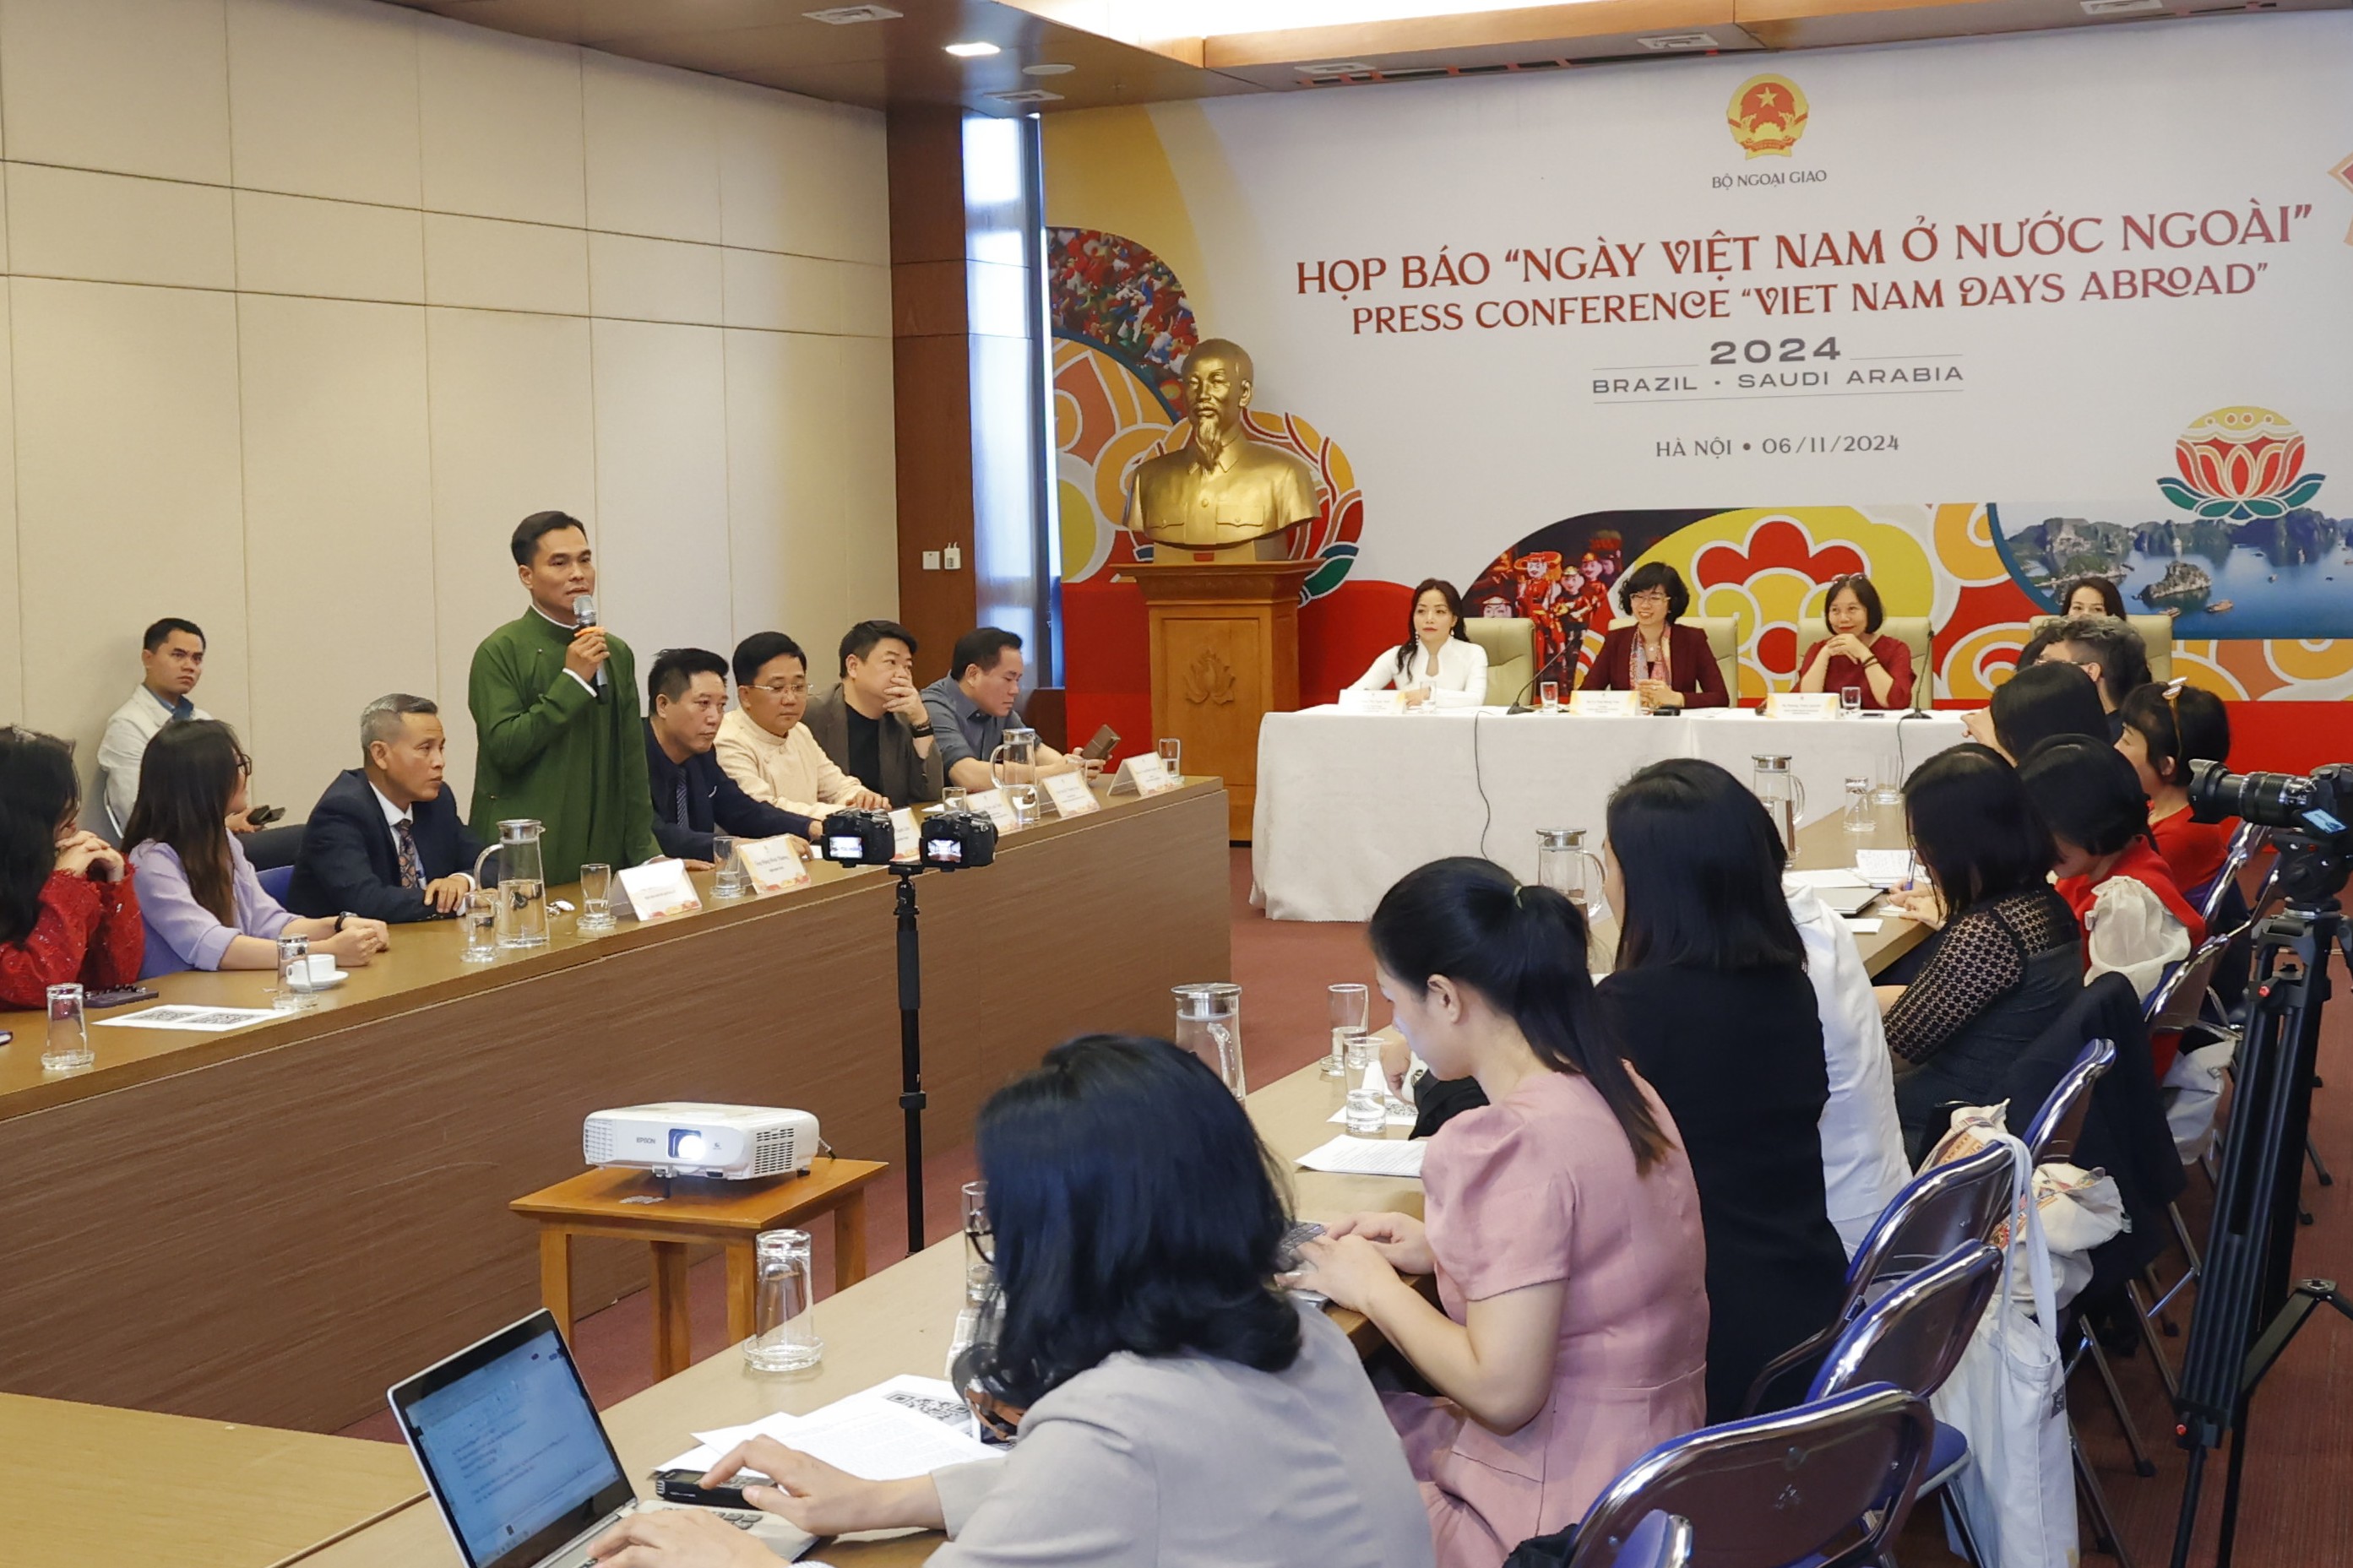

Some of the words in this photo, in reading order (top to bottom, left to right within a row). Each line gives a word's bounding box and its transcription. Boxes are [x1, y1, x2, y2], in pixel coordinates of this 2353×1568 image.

[1712, 173, 1733, 191] BỘ
[1736, 172, 1785, 187] NGOẠI
[1789, 170, 1828, 183] GIAO
[1296, 258, 1387, 301] HỌP
[1401, 244, 1491, 290] BÁO
[1660, 229, 1760, 282] VIỆT
[1774, 229, 1886, 269] NAM
[1902, 215, 1939, 263] Ở
[1955, 209, 2104, 260] NƯỚC
[1352, 303, 1465, 335] PRESS
[1475, 289, 1731, 329] CONFERENCE
[1851, 279, 1945, 312] NAM
[1959, 273, 2065, 307] DAYS
[1709, 336, 1841, 365] 2024
[1593, 377, 1698, 394] BRAZIL
[1738, 371, 1829, 388] SAUDI
[1846, 366, 1964, 384] ARABIA
[1656, 437, 1687, 457] HÀ
[1694, 437, 1731, 459] NỘI
[1762, 435, 1899, 454] 06/11/2024
